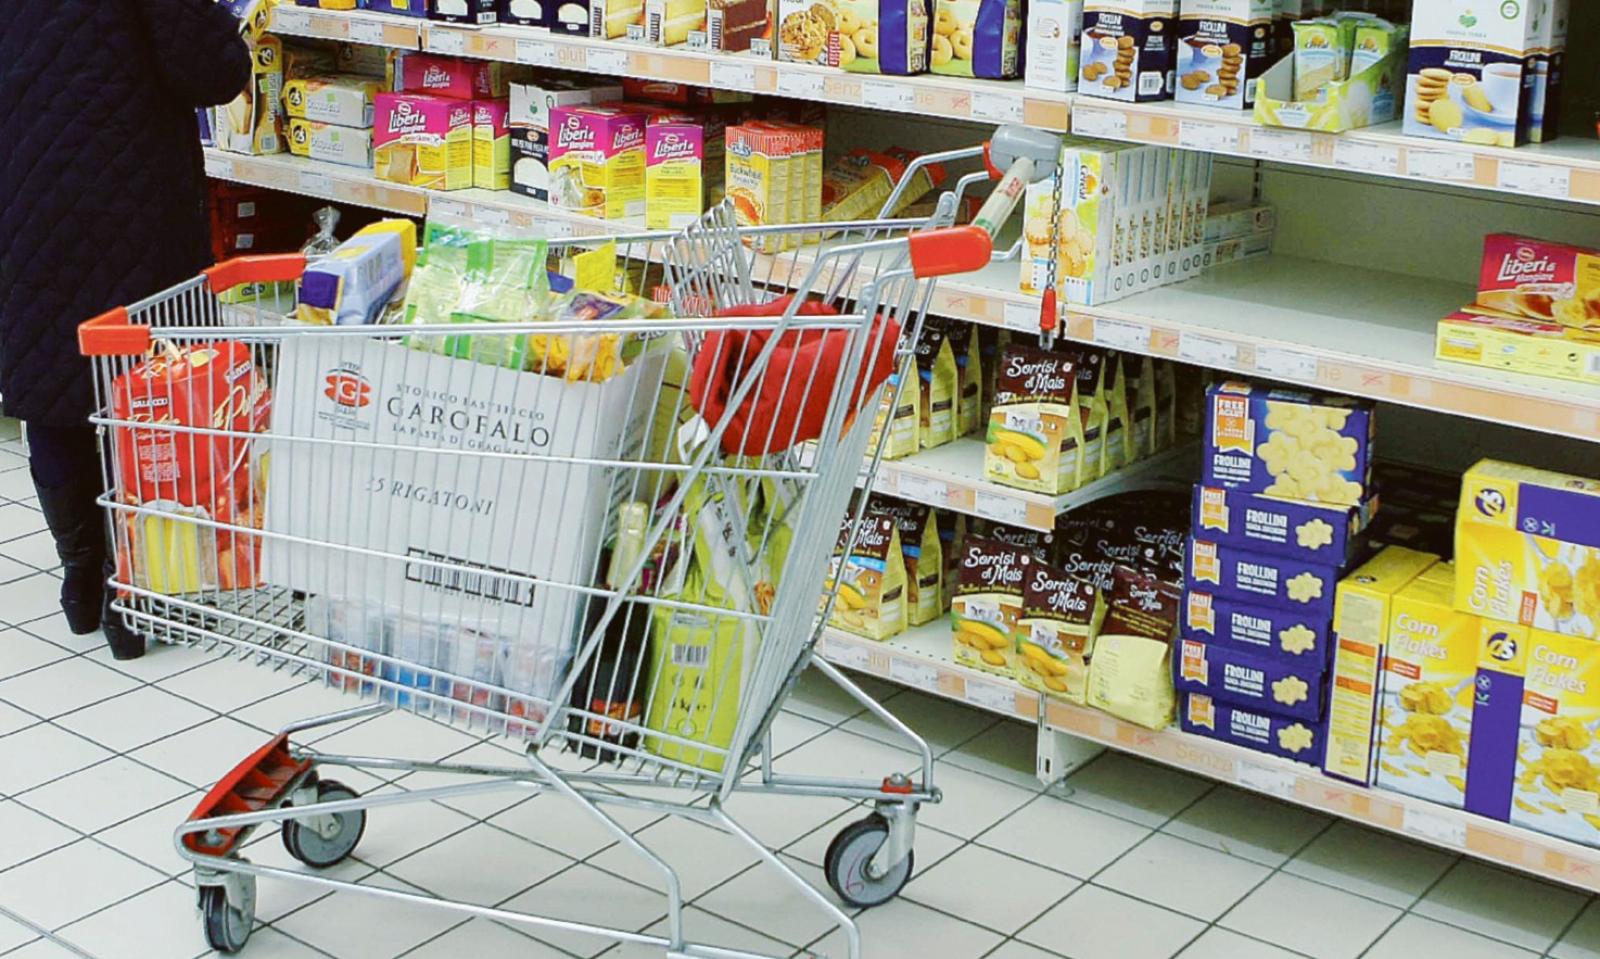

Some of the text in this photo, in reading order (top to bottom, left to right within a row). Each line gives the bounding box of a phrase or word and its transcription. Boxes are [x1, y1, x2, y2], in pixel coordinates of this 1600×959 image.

[388, 110, 421, 133] Liberi
[558, 123, 588, 148] Liberi
[654, 140, 688, 158] Liberi
[1497, 253, 1548, 281] Liberi
[1007, 356, 1059, 378] Sorrisi
[1030, 373, 1065, 395] Mais
[1214, 453, 1251, 469] FROLLINI
[391, 480, 493, 515] RIGATONI
[1247, 509, 1288, 528] FROLLINI
[964, 547, 1016, 568] Sorrisi
[1065, 553, 1115, 574] Sorrisi
[987, 564, 1023, 585] Mais
[1237, 562, 1278, 581] FROLLINI
[1031, 571, 1079, 595] Sorrisi
[1468, 565, 1489, 611] Corn
[1491, 559, 1513, 616] Flakes
[1052, 591, 1088, 613] Mais
[1232, 612, 1271, 633] FROLLINI
[1397, 612, 1439, 636] Corn
[1395, 634, 1448, 660] Flakes
[1535, 644, 1577, 670] Corn
[1225, 663, 1264, 684] FROLLINI
[1534, 665, 1587, 695] Flakes
[1231, 709, 1270, 729] FROLLINI
